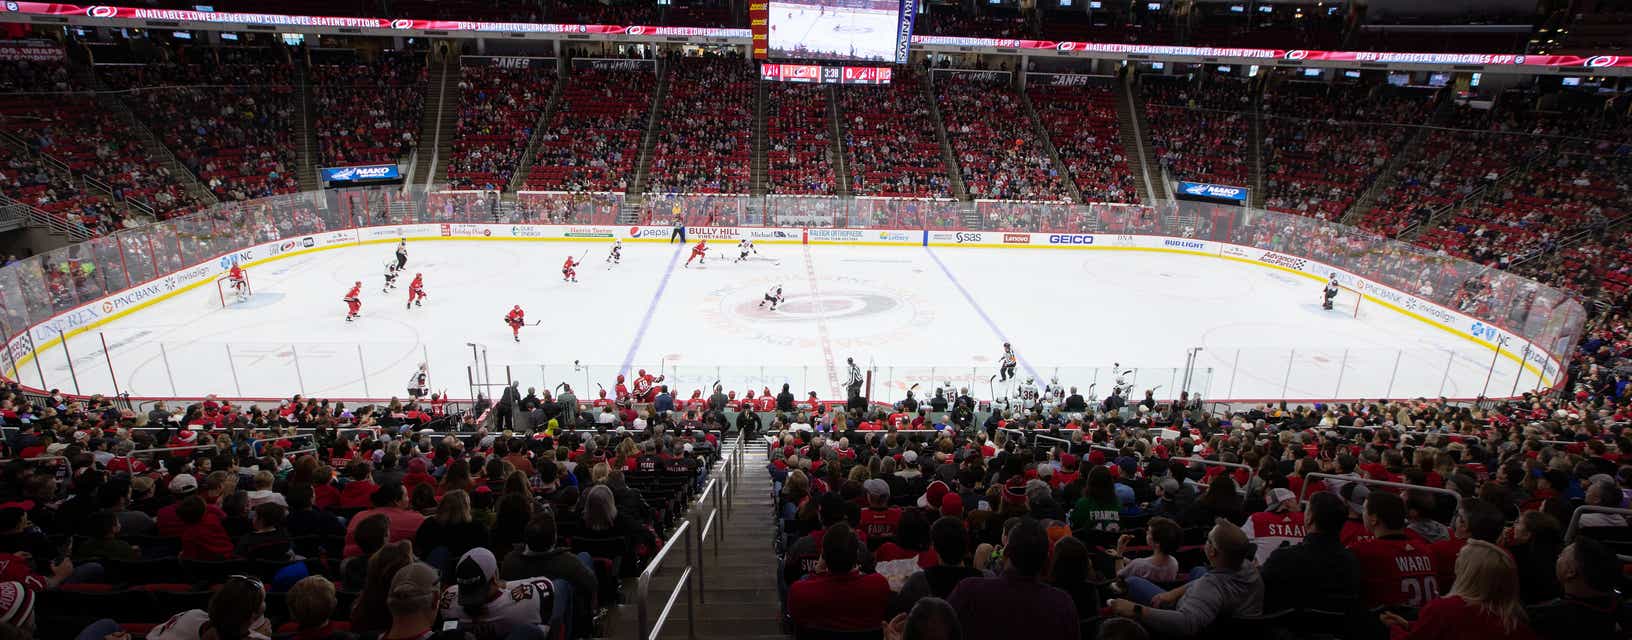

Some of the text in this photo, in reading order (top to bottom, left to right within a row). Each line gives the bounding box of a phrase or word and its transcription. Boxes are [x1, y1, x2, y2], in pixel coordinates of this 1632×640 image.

[135, 8, 380, 27] AVAILABLE LOWER LEVEL AND CLUB LEVEL SEATING OPTIONS
[457, 22, 475, 31] OPEN
[522, 24, 563, 33] HURRICANES
[565, 25, 577, 33] APP
[656, 27, 688, 35] AVAILABLE
[690, 28, 710, 36] LOWER
[21, 47, 64, 55] WRAPS
[1086, 43, 1117, 51] AVAILABLE
[1118, 44, 1140, 53] LOWER
[1213, 49, 1241, 57] SEATING
[1243, 49, 1275, 57] OPTIONS
[491, 57, 529, 68] CANES
[1356, 53, 1511, 63] OPEN THE OFFICIAL HURRICANES APP
[825, 69, 838, 78] 3:38
[846, 69, 852, 78] 0
[1050, 74, 1088, 86] CANES
[356, 167, 390, 175] MAKO
[1208, 187, 1240, 195] MAKO
[643, 229, 669, 238] pepsi
[688, 227, 740, 236] BULLY HILL
[963, 233, 982, 242] sas
[1049, 235, 1093, 244] GEICO
[1181, 241, 1204, 249] LIGHT
[240, 251, 253, 262] NC
[1258, 257, 1273, 265] Auto
[1263, 251, 1295, 264] Advance
[177, 267, 209, 283] invisalign
[113, 285, 160, 308] PNC BANK
[67, 305, 98, 327] REX
[1496, 333, 1511, 347] NC
[946, 391, 954, 403] 15
[763, 400, 768, 410] 7
[1395, 556, 1431, 572] WARD
